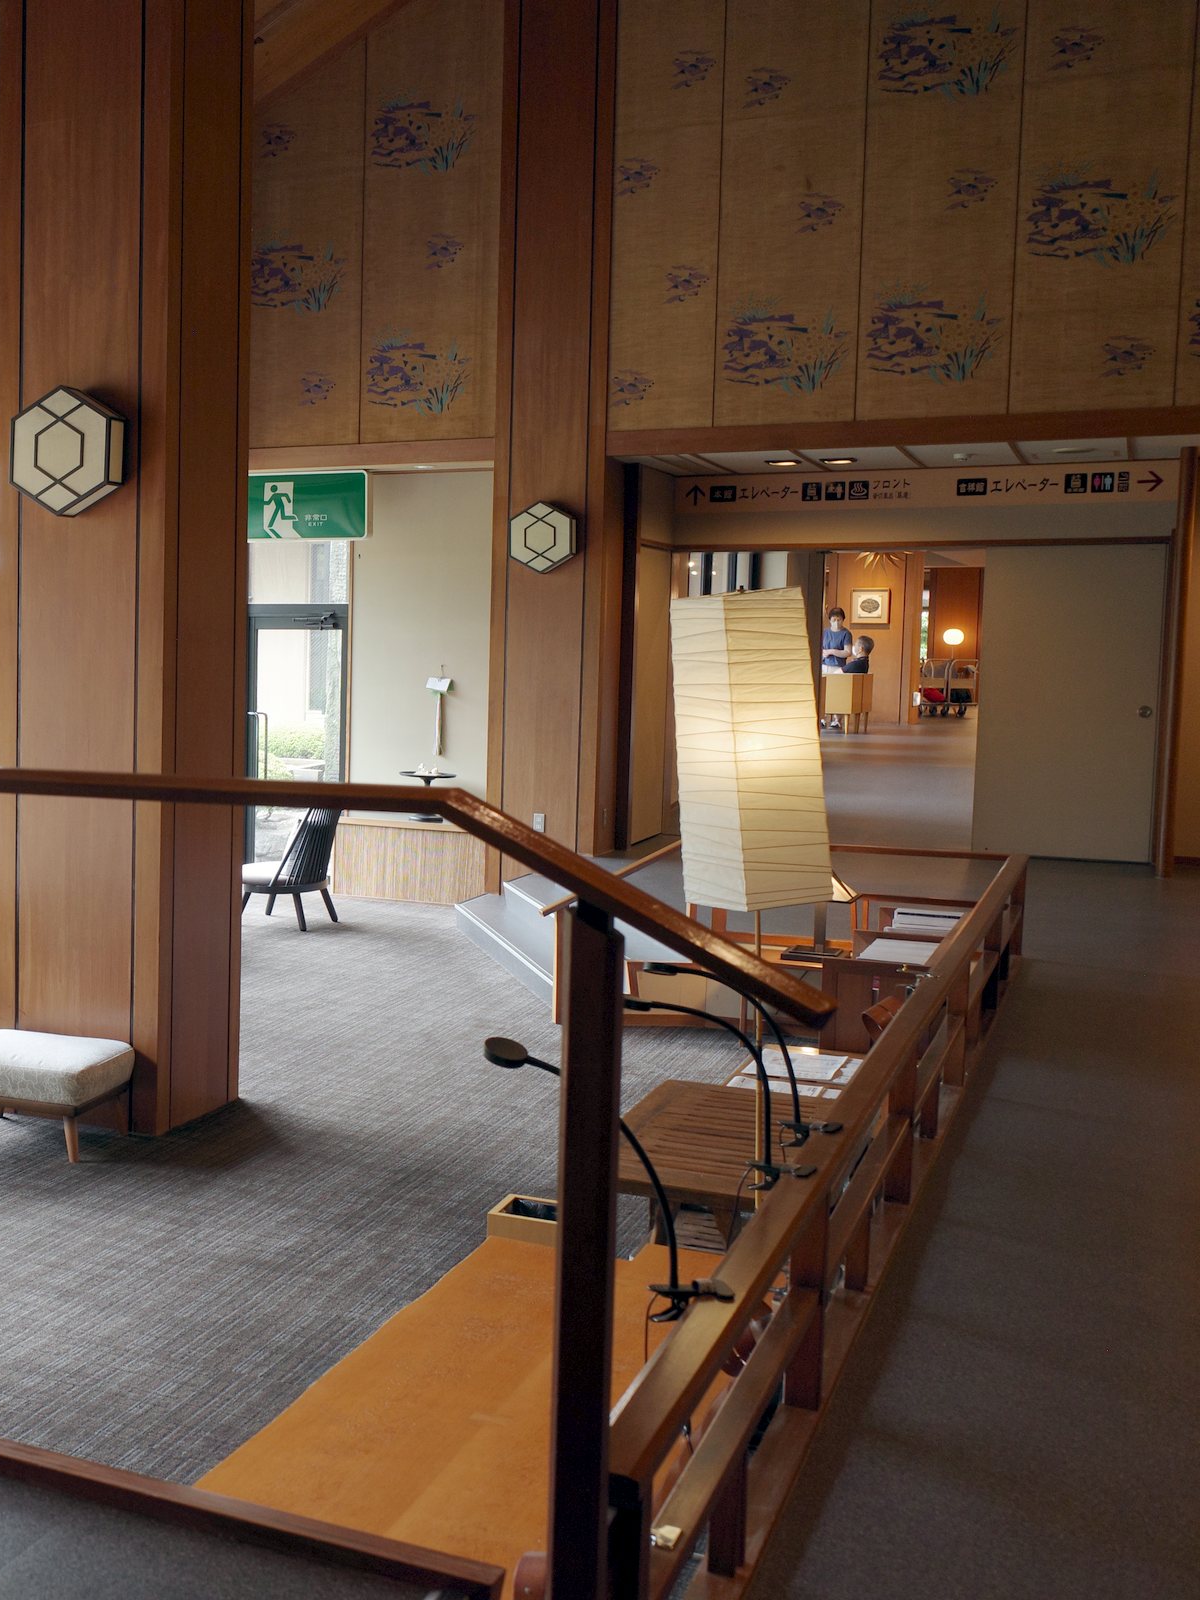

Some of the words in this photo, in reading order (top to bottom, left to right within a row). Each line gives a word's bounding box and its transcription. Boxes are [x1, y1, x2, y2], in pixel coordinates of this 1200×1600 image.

[872, 478, 911, 490] フロント
[990, 478, 1059, 493] エレベーター
[738, 486, 798, 500] エレベーター
